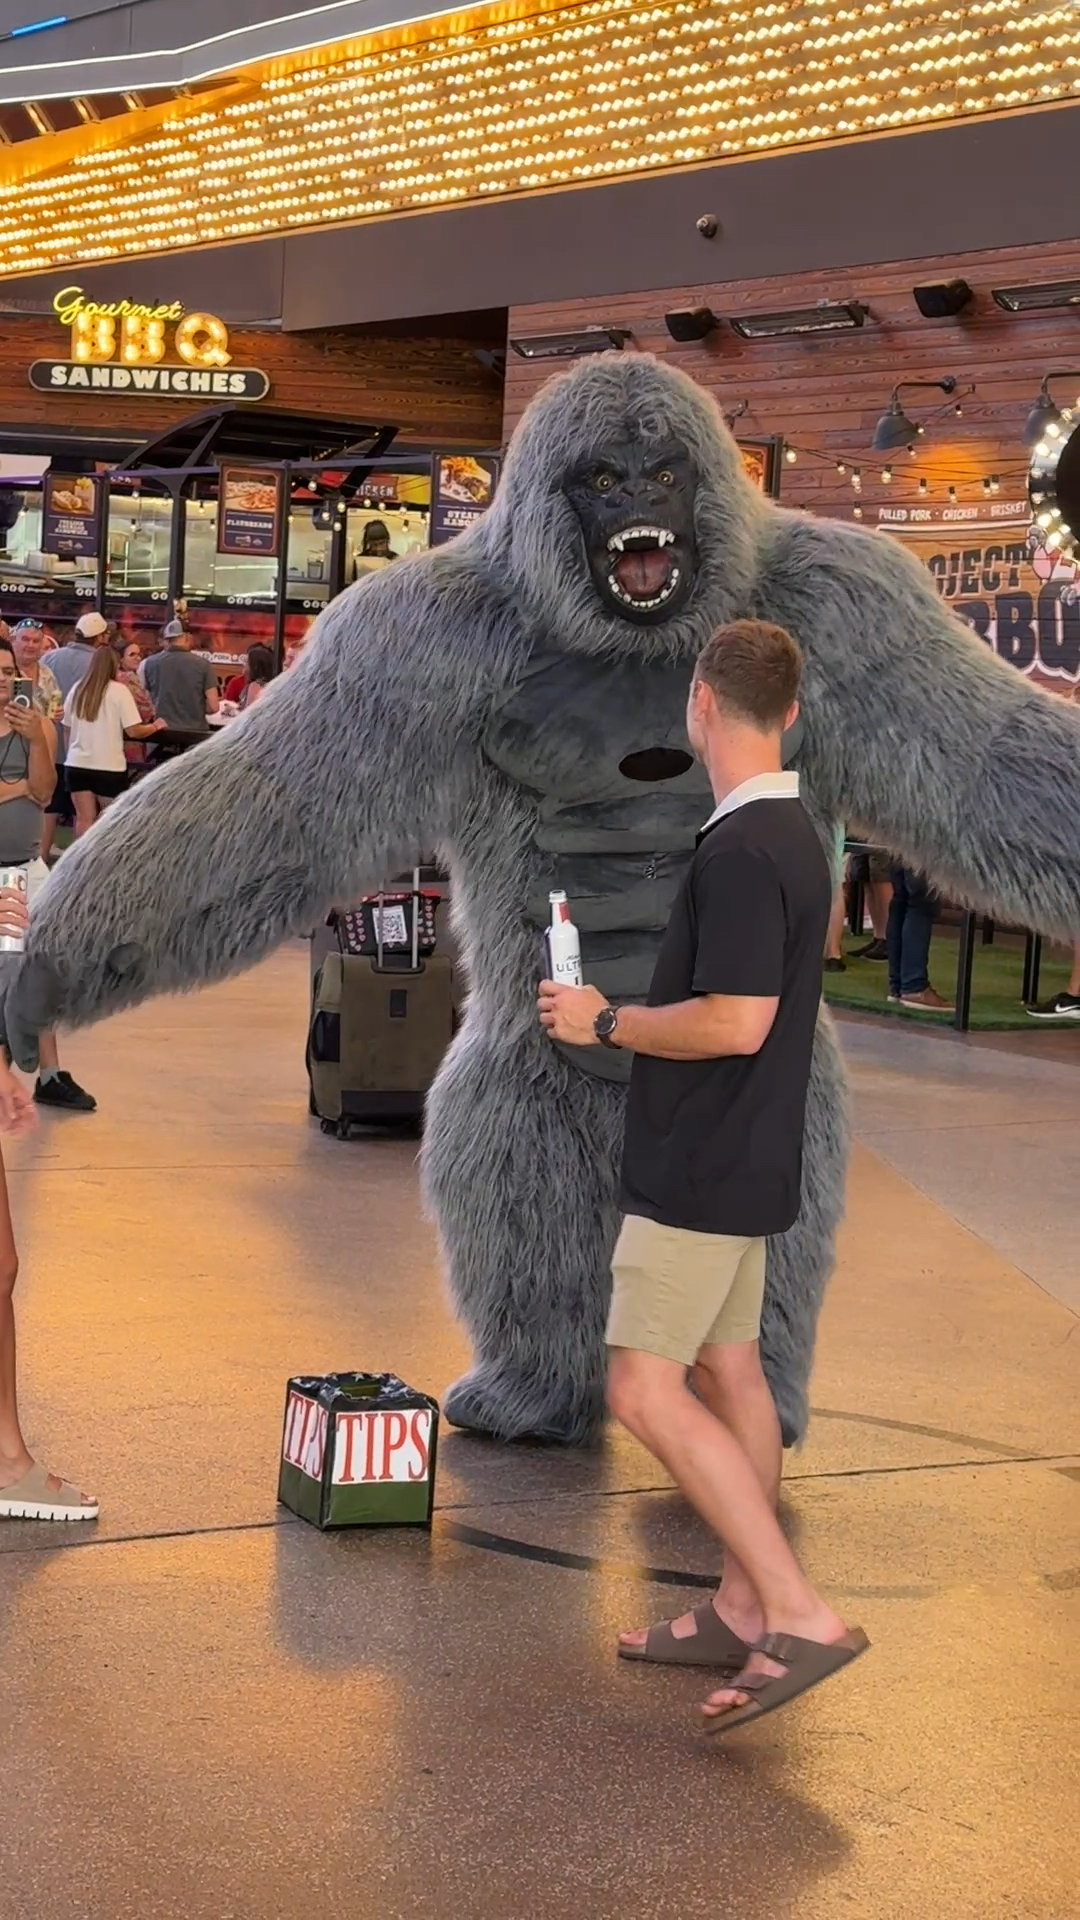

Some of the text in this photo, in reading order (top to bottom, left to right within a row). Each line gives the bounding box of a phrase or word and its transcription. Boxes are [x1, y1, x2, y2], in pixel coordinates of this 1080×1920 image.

[53, 286, 184, 325] Gourmet
[71, 312, 232, 368] BBQ
[51, 366, 246, 394] SANDWICHES
[878, 501, 1027, 521] PULLED PORK CHICKEN BRISKET
[928, 542, 1030, 598] OJECT
[285, 1391, 327, 1479] TIPS
[336, 1410, 430, 1482] TIPS
